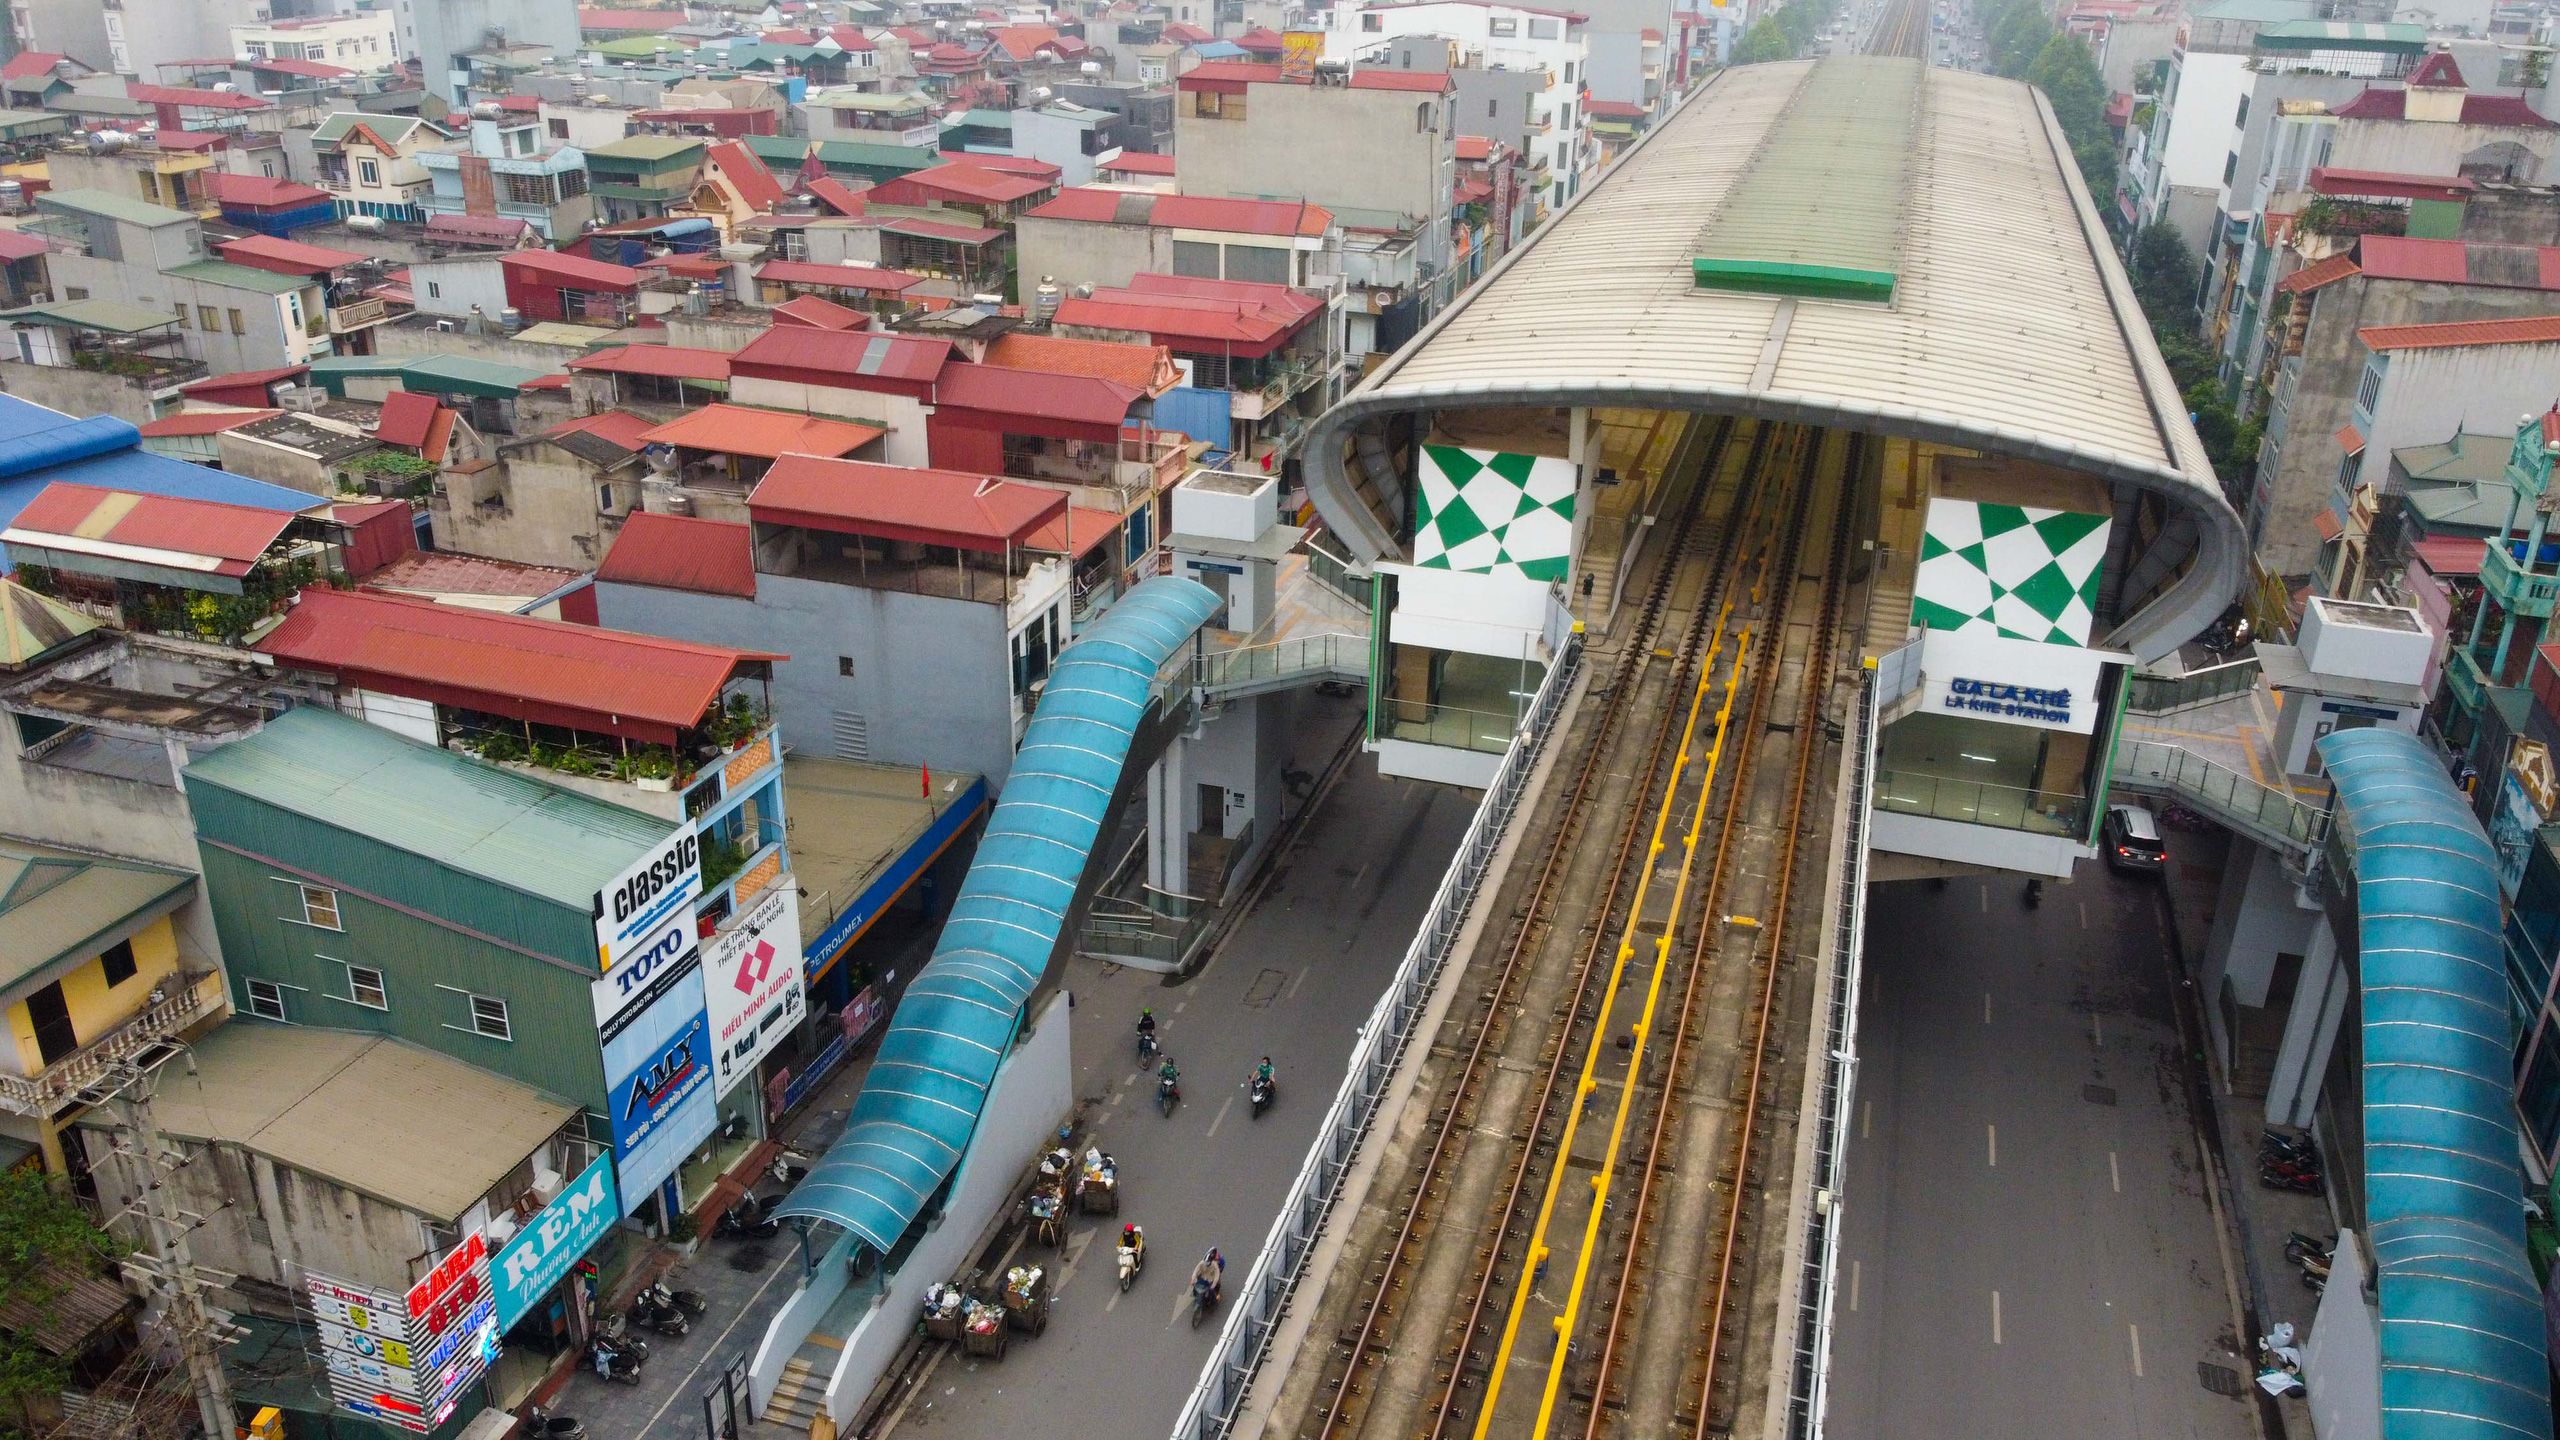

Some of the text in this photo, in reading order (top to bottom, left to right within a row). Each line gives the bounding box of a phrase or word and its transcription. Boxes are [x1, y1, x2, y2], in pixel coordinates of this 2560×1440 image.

[1945, 695, 2070, 724] LA KHE STATION
[1952, 678, 2072, 708] GA LA KHÊ
[614, 835, 697, 923] classic
[766, 902, 785, 925] NGHỆ
[810, 912, 863, 968] PETROLIMEX
[616, 928, 682, 996] TOTO
[618, 1008, 633, 1025] TOTO
[722, 1015, 742, 1041] HIẾU
[744, 992, 766, 1021] MINH
[768, 967, 793, 999] AUDIO
[624, 1031, 693, 1121] AMY
[503, 1170, 606, 1292] RÈM
[574, 1212, 600, 1248] Anh
[409, 1232, 488, 1319] GARA
[429, 1331, 459, 1369] VIỆT
